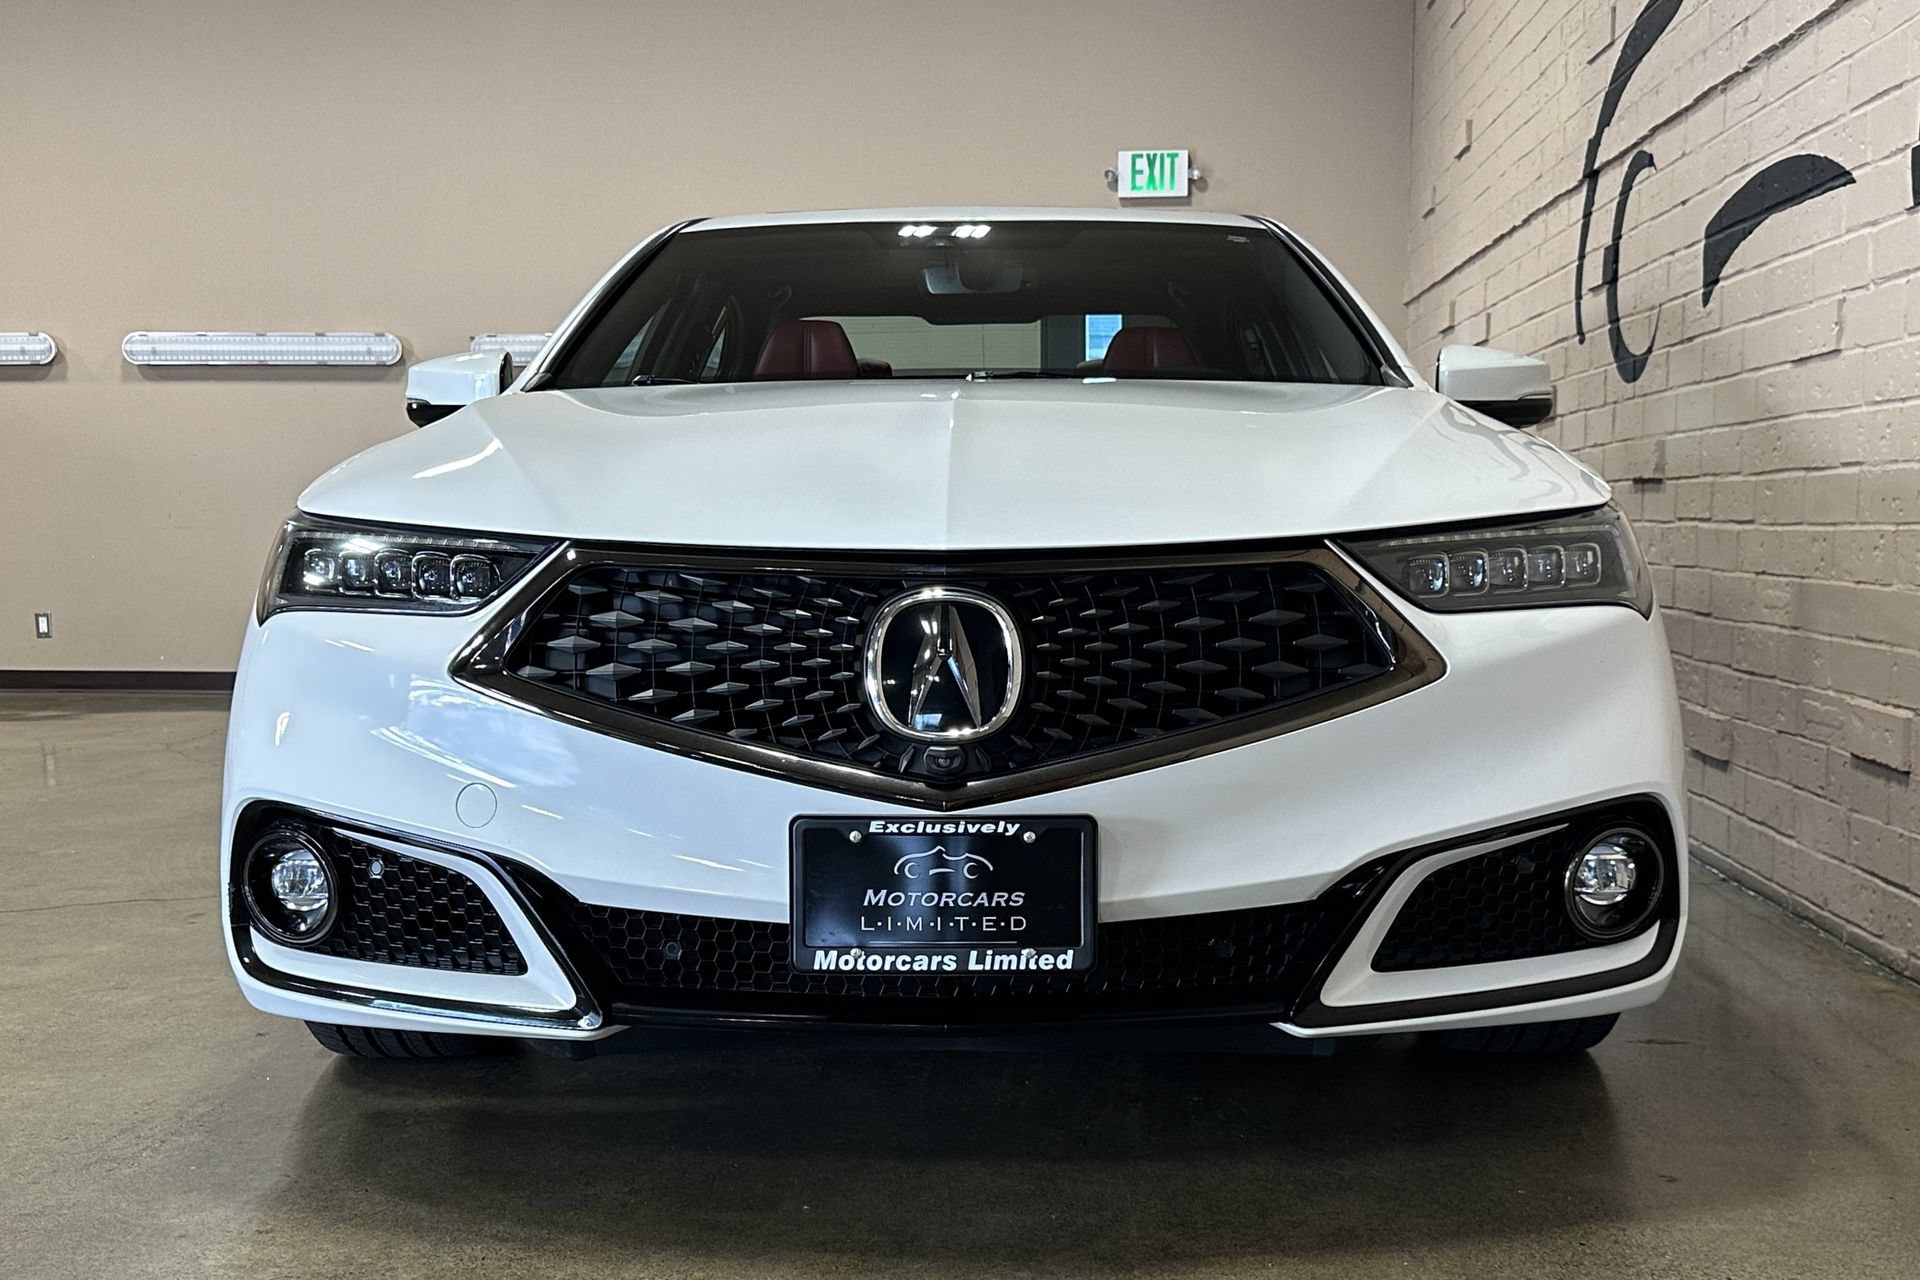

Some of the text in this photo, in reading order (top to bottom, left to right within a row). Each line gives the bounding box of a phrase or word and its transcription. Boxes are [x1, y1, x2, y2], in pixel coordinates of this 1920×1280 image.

[1131, 152, 1179, 191] EXIT
[869, 820, 1020, 835] Exclusively
[813, 949, 1074, 971] Motorcars Limited
